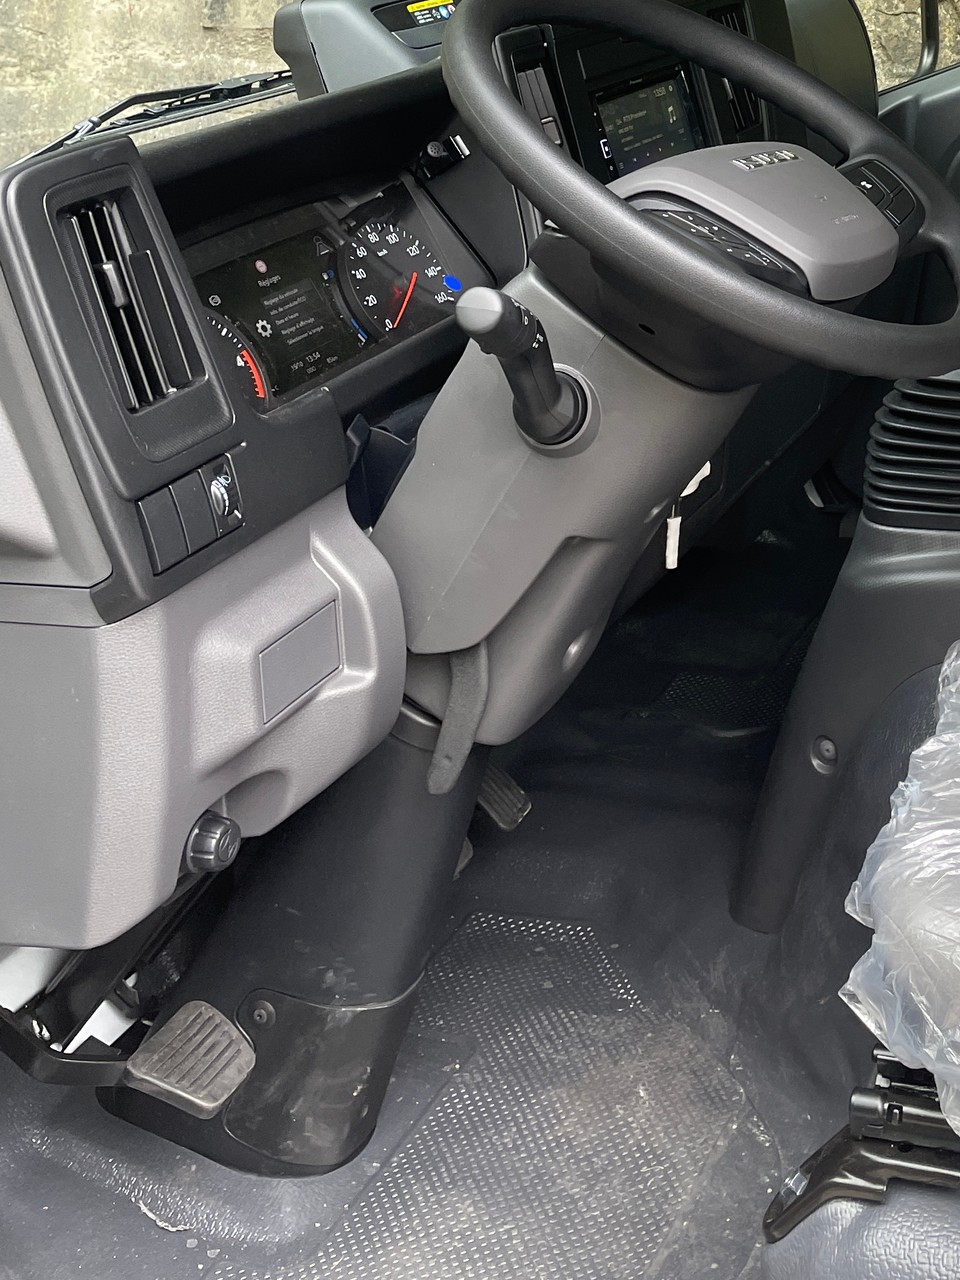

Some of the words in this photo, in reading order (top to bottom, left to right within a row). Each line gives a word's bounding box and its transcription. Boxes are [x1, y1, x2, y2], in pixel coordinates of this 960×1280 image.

[367, 232, 379, 243] 80
[386, 233, 399, 244] 100
[356, 247, 367, 257] 60
[406, 245, 419, 256] 120
[355, 268, 367, 280] 40
[425, 266, 438, 278] 140
[365, 295, 377, 307] 20
[435, 292, 447, 303] 160
[385, 319, 393, 329] 0
[236, 355, 245, 367] 4
